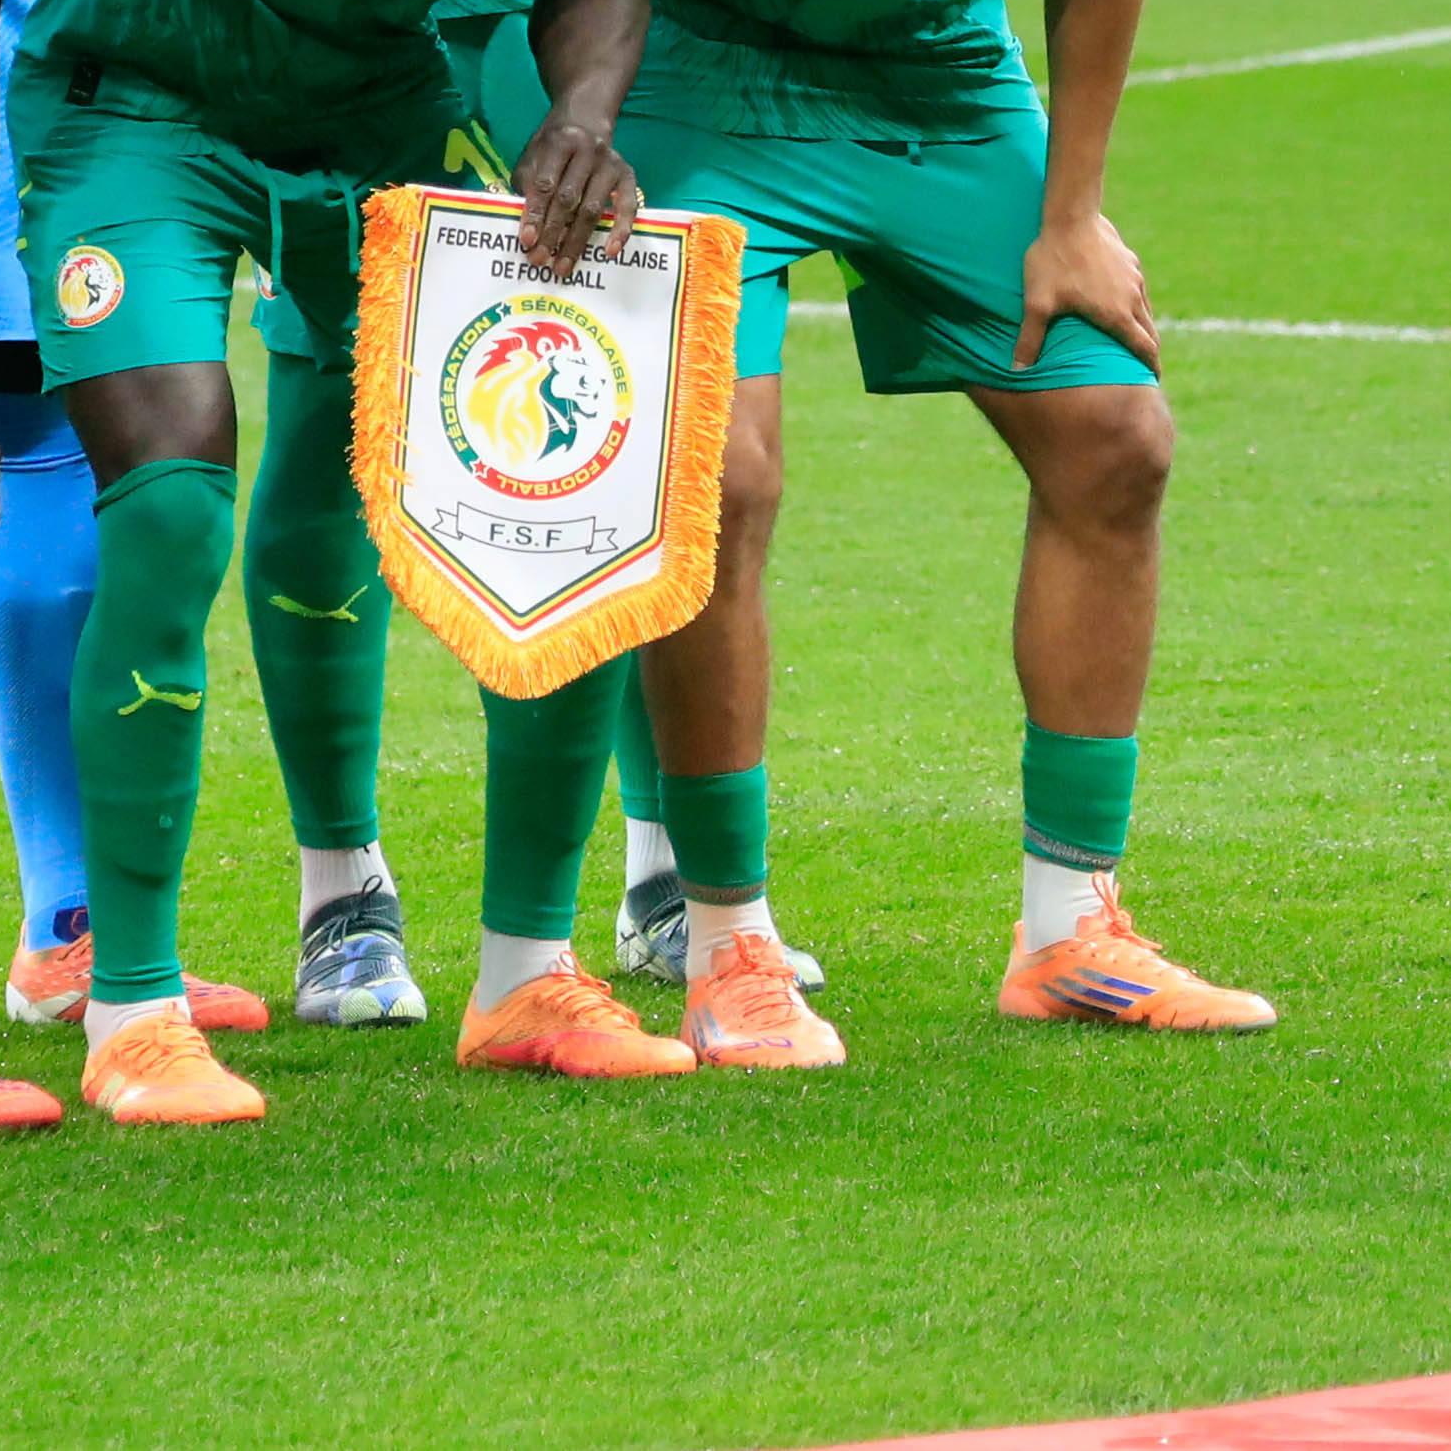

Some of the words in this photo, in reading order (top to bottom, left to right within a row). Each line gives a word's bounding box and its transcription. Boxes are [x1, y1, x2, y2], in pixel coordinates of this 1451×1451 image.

[437, 227, 529, 255] FEDERATI
[581, 243, 670, 271] EGALAISE
[491, 260, 514, 280] DE
[520, 296, 628, 394] SÉNÉGALAISE
[440, 316, 493, 452] FÉDÉRATION
[600, 429, 622, 459] DE
[497, 460, 603, 496] FOOTBALL
